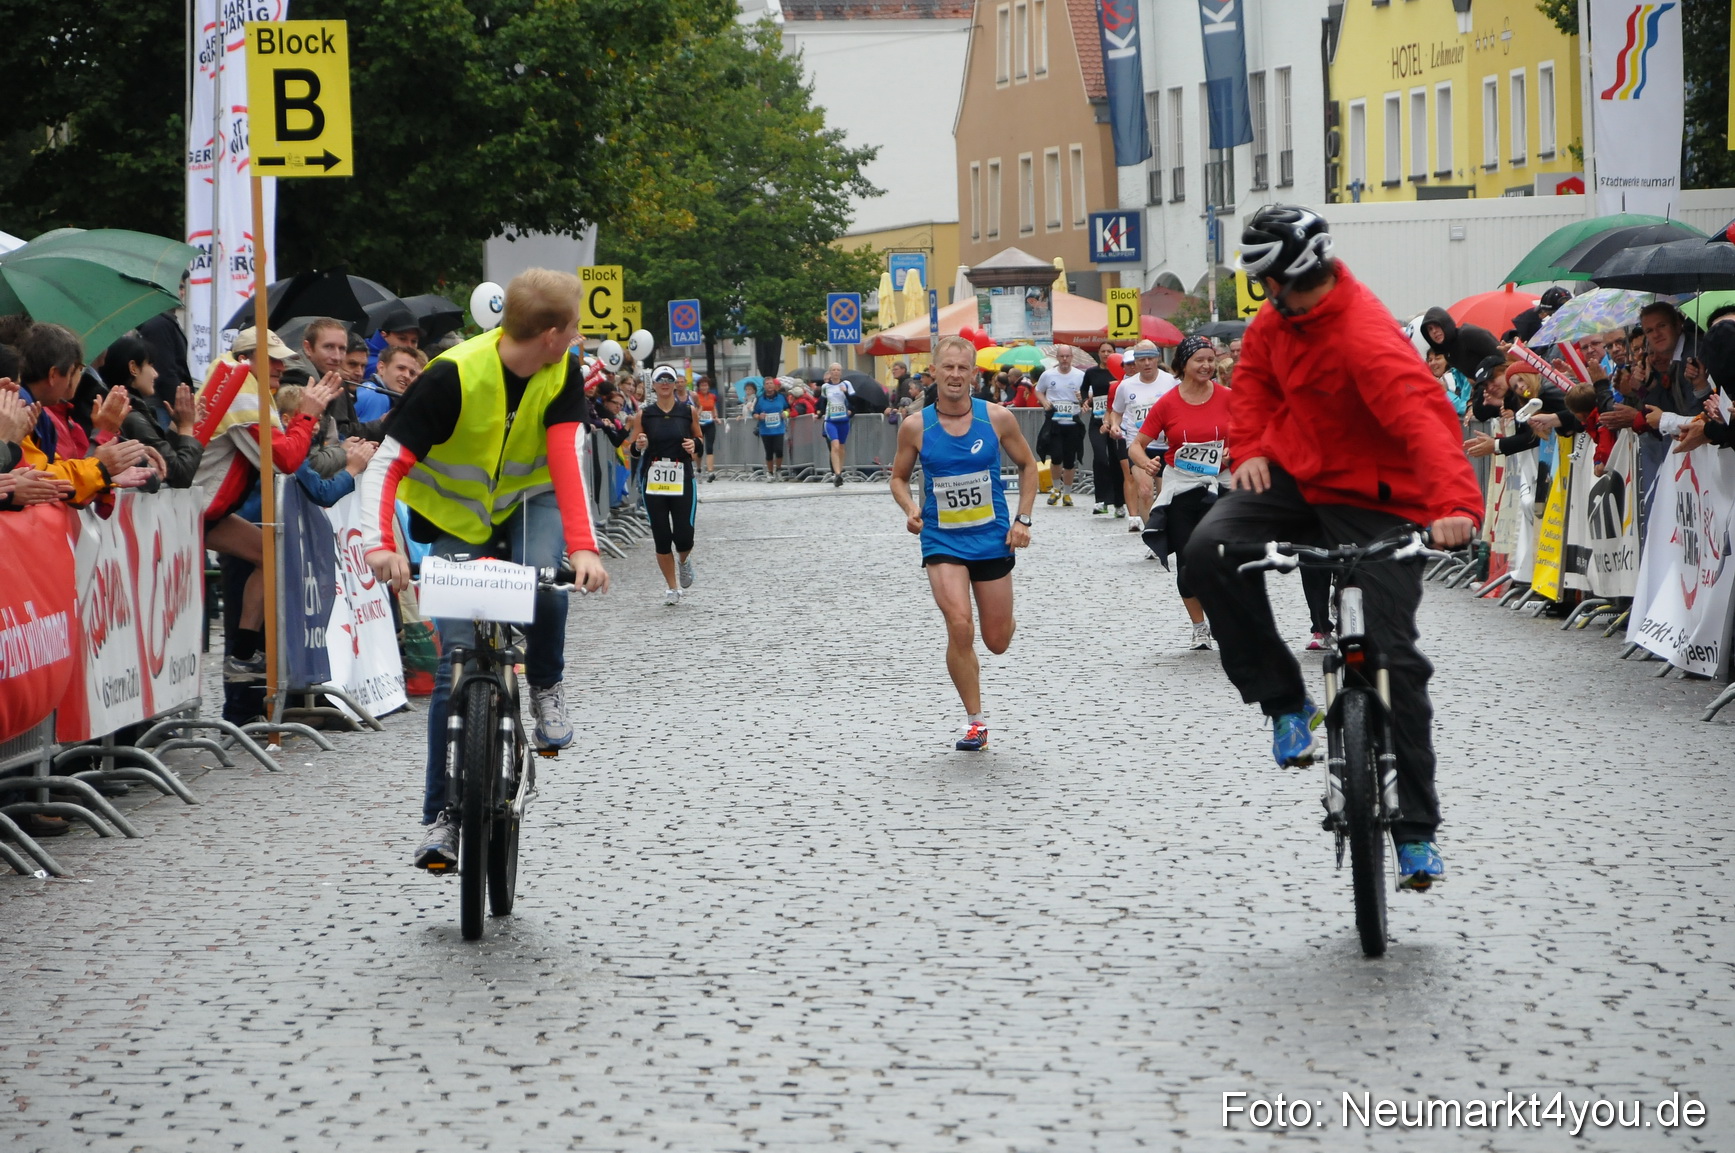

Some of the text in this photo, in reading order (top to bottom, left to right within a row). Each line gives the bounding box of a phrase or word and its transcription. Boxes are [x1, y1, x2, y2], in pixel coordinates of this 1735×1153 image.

[256, 27, 336, 54] Block
[1392, 38, 1465, 79] HOTEL Lehmeier
[273, 68, 325, 141] B
[582, 268, 618, 281] Block
[588, 286, 611, 319] C
[1110, 290, 1138, 300] Block
[1116, 304, 1133, 328] D
[673, 331, 698, 343] TAXI
[831, 329, 858, 340] TAXI
[1180, 447, 1218, 464] 2279
[654, 469, 676, 482] 310
[953, 478, 981, 487] Neumarkt
[946, 486, 982, 509] 555
[433, 561, 526, 576] Erster Mann
[424, 572, 533, 592] Halbmarathon
